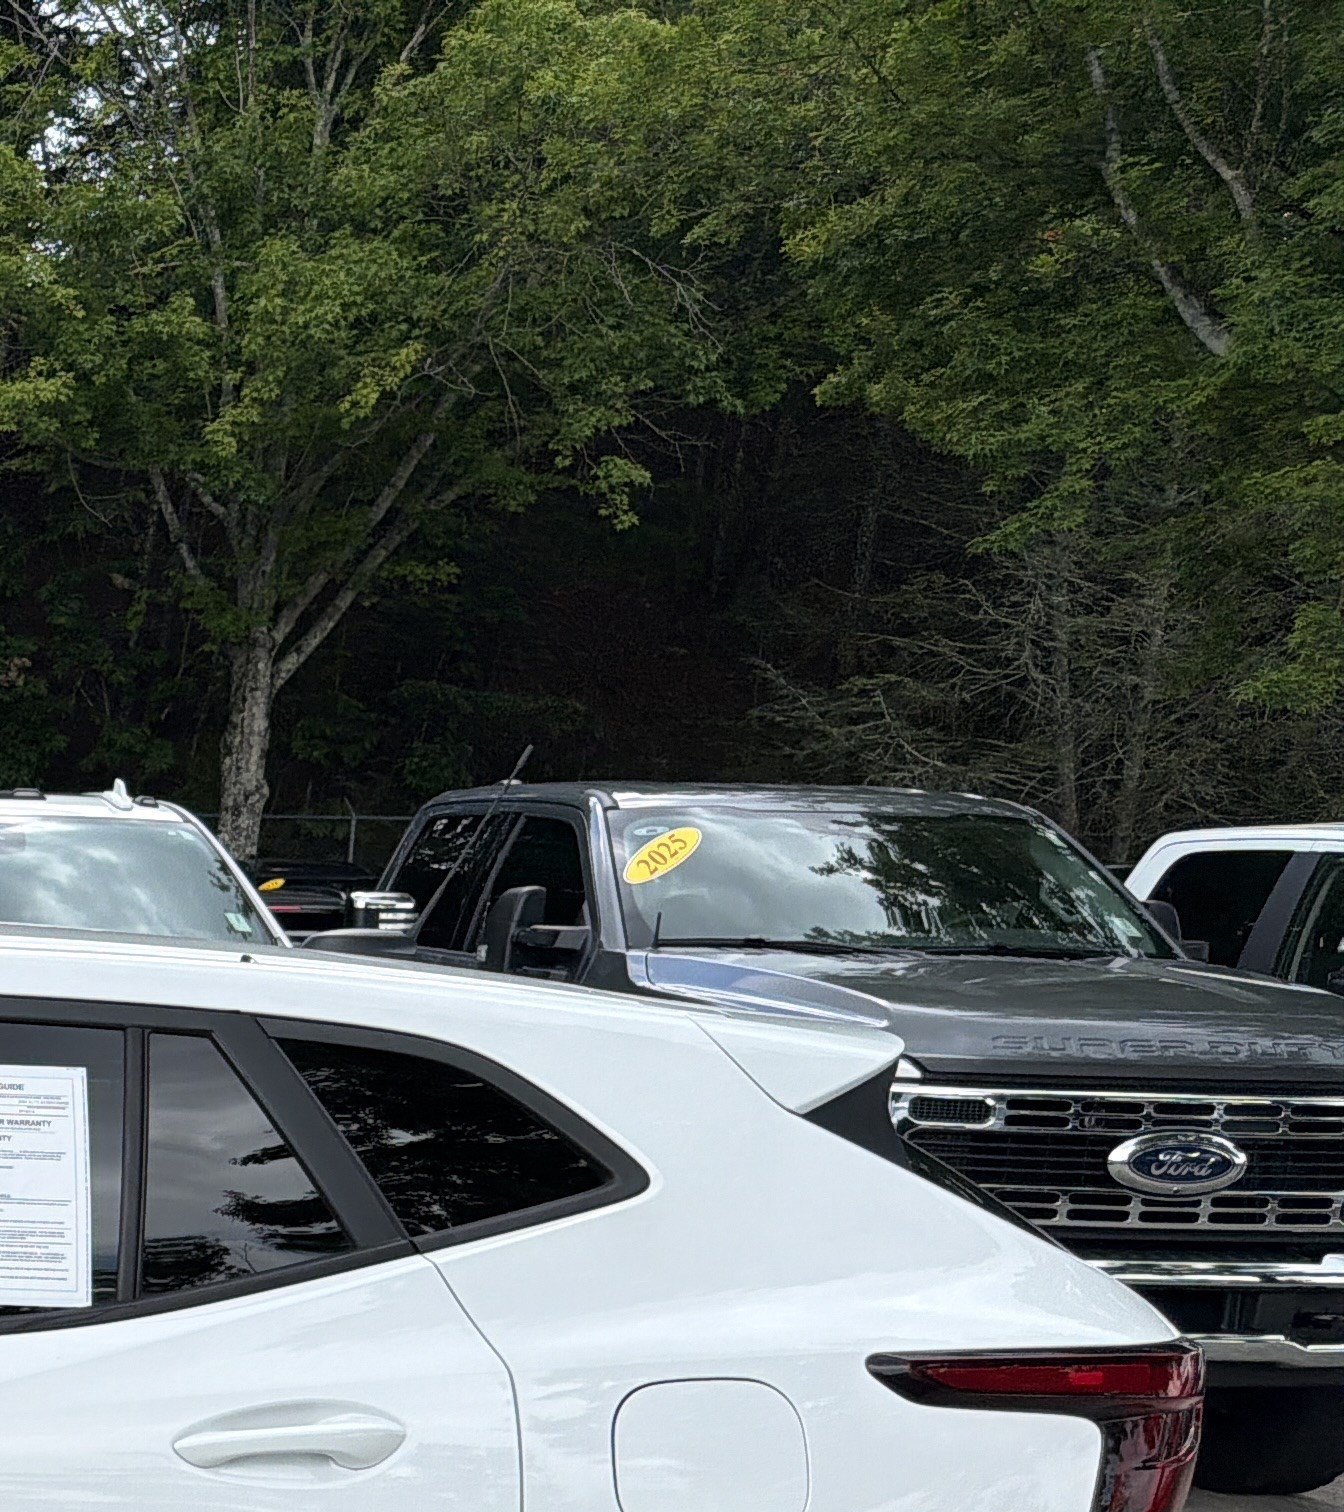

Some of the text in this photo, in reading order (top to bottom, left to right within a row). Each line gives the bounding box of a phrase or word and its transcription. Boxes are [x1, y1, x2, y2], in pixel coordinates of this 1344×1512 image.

[636, 833, 688, 876] 2025
[991, 1035, 1195, 1058] SUPER
[6, 1118, 52, 1127] WARRANTY
[1149, 1149, 1216, 1177] Ford
